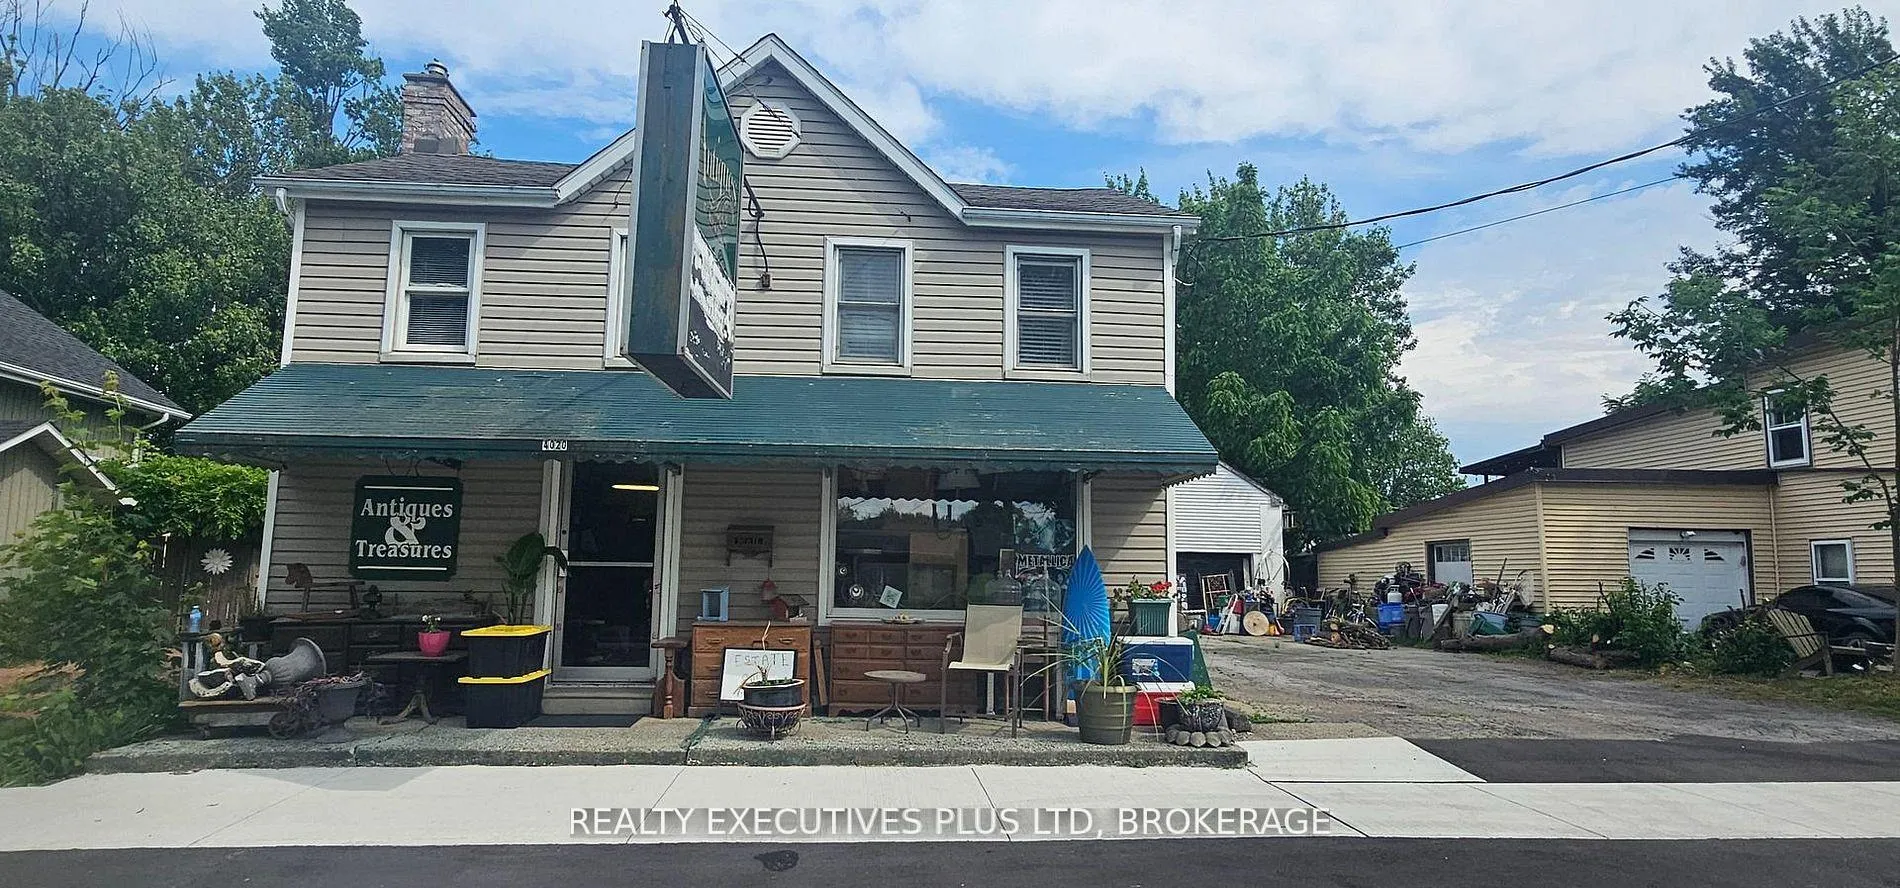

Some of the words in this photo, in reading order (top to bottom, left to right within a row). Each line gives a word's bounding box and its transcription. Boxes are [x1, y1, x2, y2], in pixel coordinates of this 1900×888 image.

[543, 439, 567, 450] 4020
[360, 497, 453, 520] Antiques
[384, 512, 426, 546] &
[355, 539, 452, 559] Treasures
[1015, 553, 1076, 578] METALLICA
